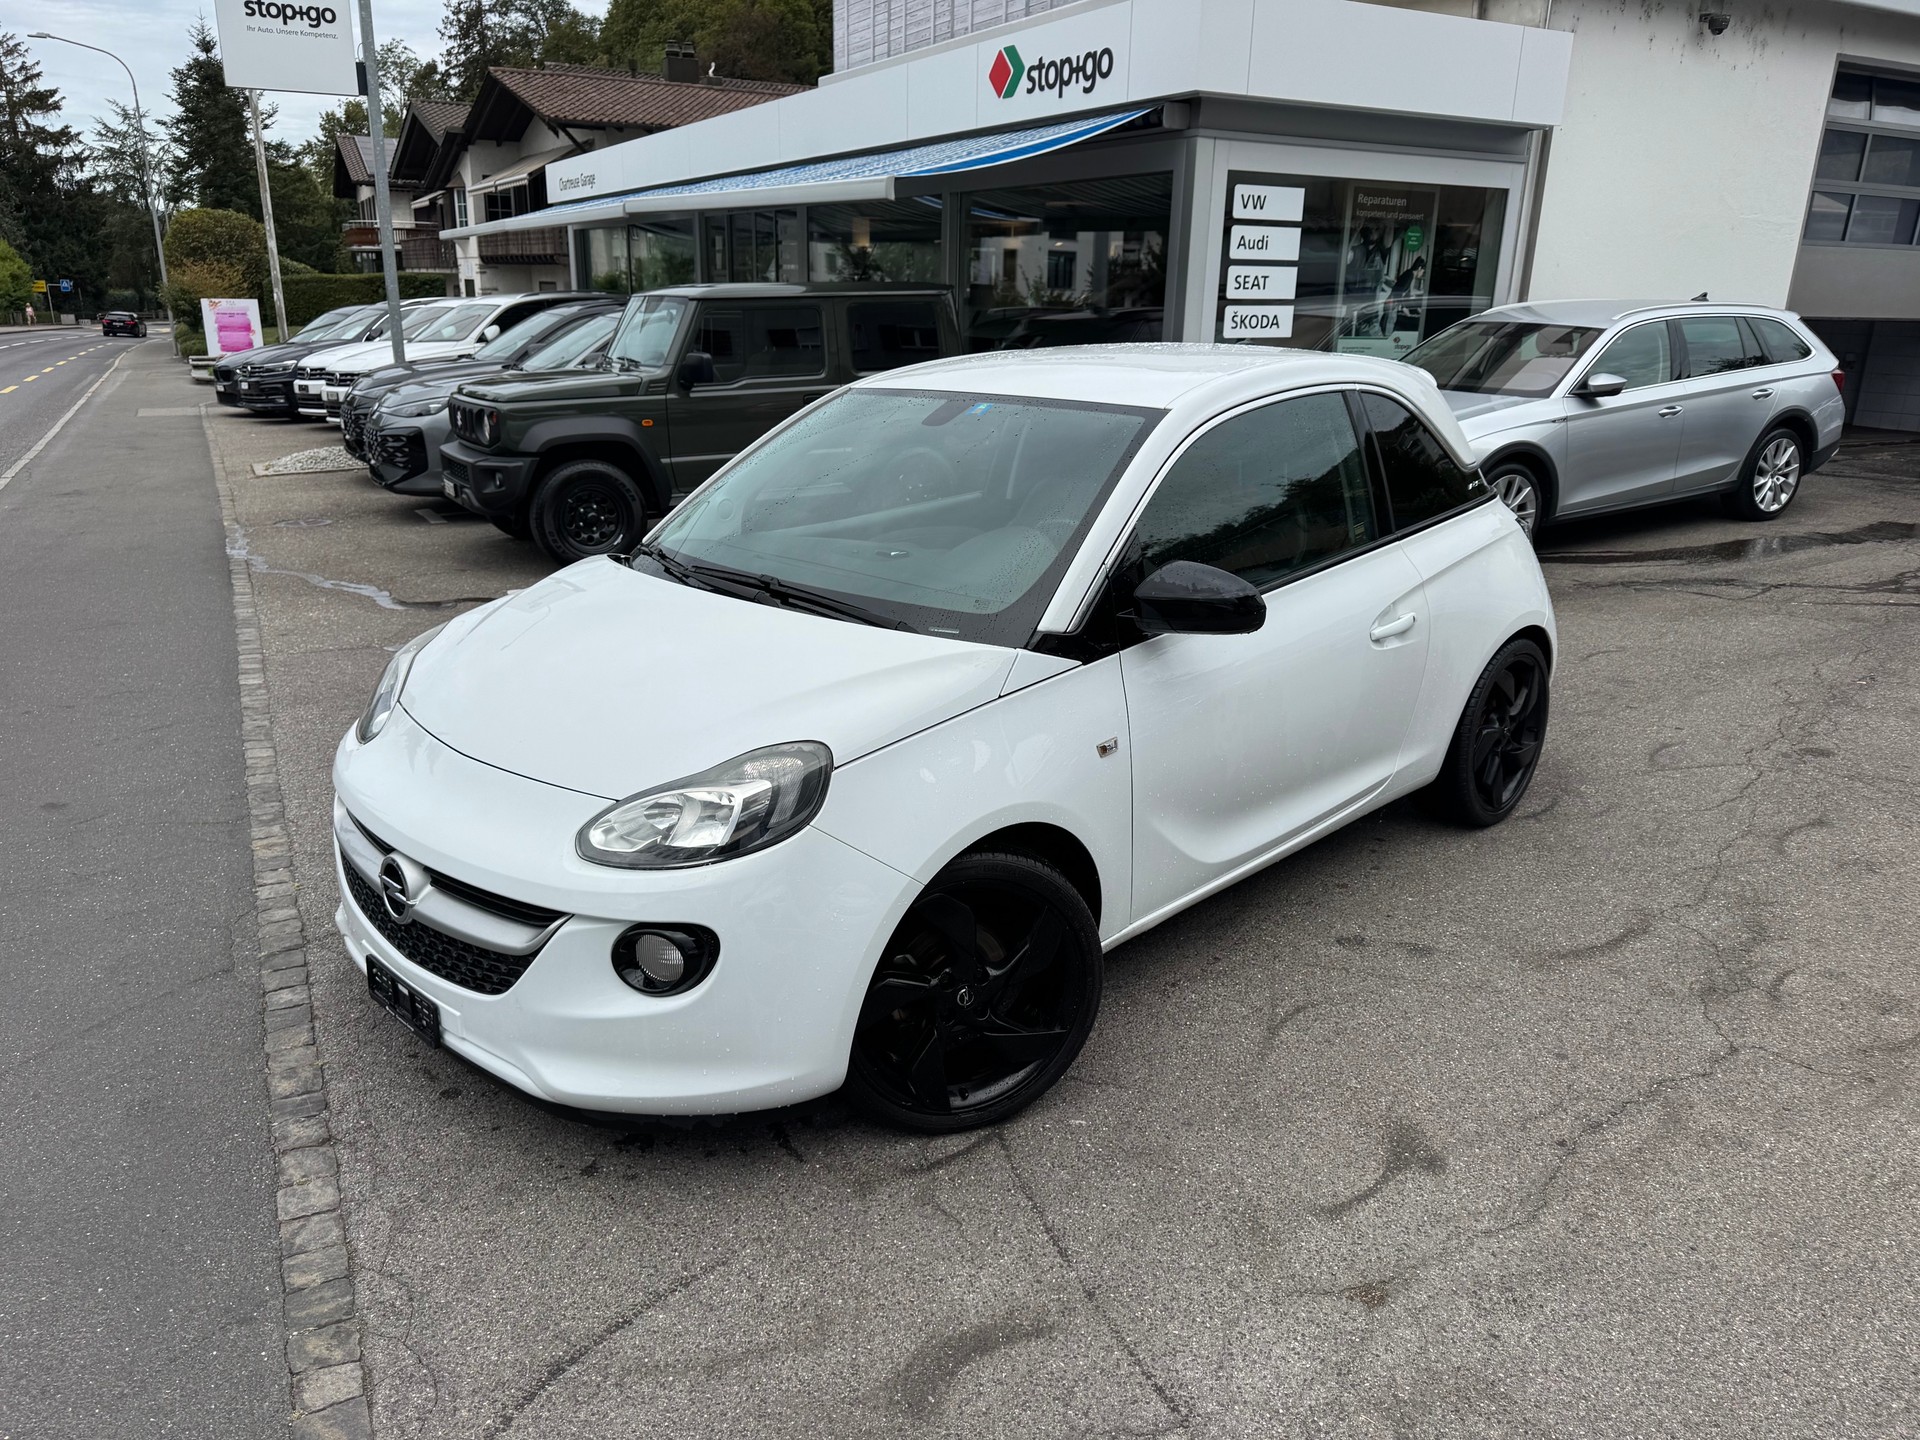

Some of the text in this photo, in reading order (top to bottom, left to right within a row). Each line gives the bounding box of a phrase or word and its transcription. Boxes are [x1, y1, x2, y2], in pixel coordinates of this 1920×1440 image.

[244, 0, 337, 28] stop+go
[257, 26, 274, 34] Auto.
[275, 28, 299, 36] Unsere
[300, 30, 339, 39] Kompetenz.
[1026, 47, 1114, 99] stop+go
[1241, 194, 1267, 211] VW
[1357, 193, 1407, 207] Reparaturen
[1236, 235, 1269, 251] Audi
[1234, 274, 1270, 290] SEAT
[1231, 311, 1280, 330] ŠKODA
